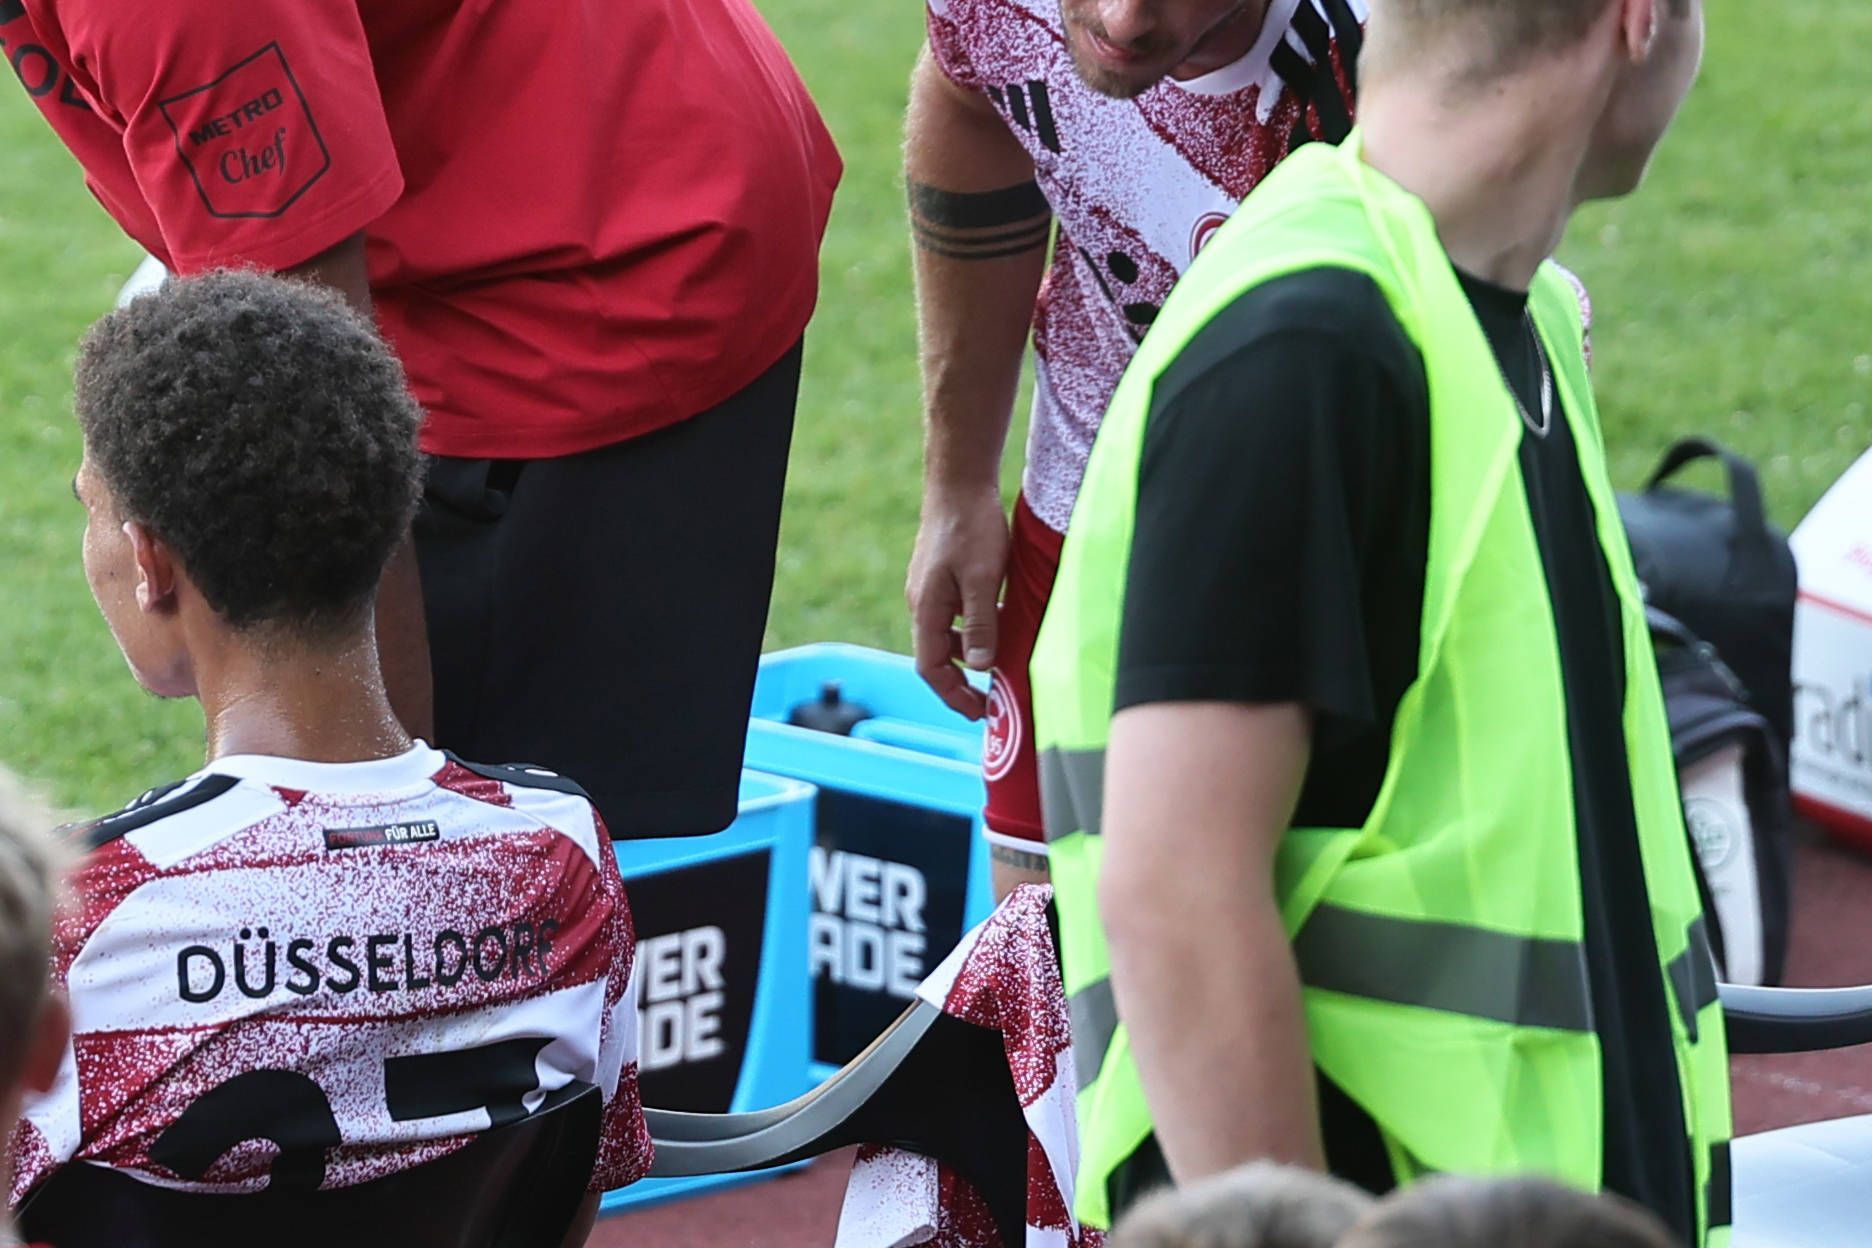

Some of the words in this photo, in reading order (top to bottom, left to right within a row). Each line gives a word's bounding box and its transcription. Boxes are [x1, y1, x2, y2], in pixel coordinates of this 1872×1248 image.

[189, 87, 284, 146] METRO
[219, 127, 287, 184] Chef
[385, 825, 409, 842] FÜR
[410, 822, 437, 839] ALLE
[176, 917, 560, 1004] DÜSSELDORF
[635, 924, 728, 1002] ER
[808, 912, 926, 999] ADE
[638, 990, 728, 1072] DE
